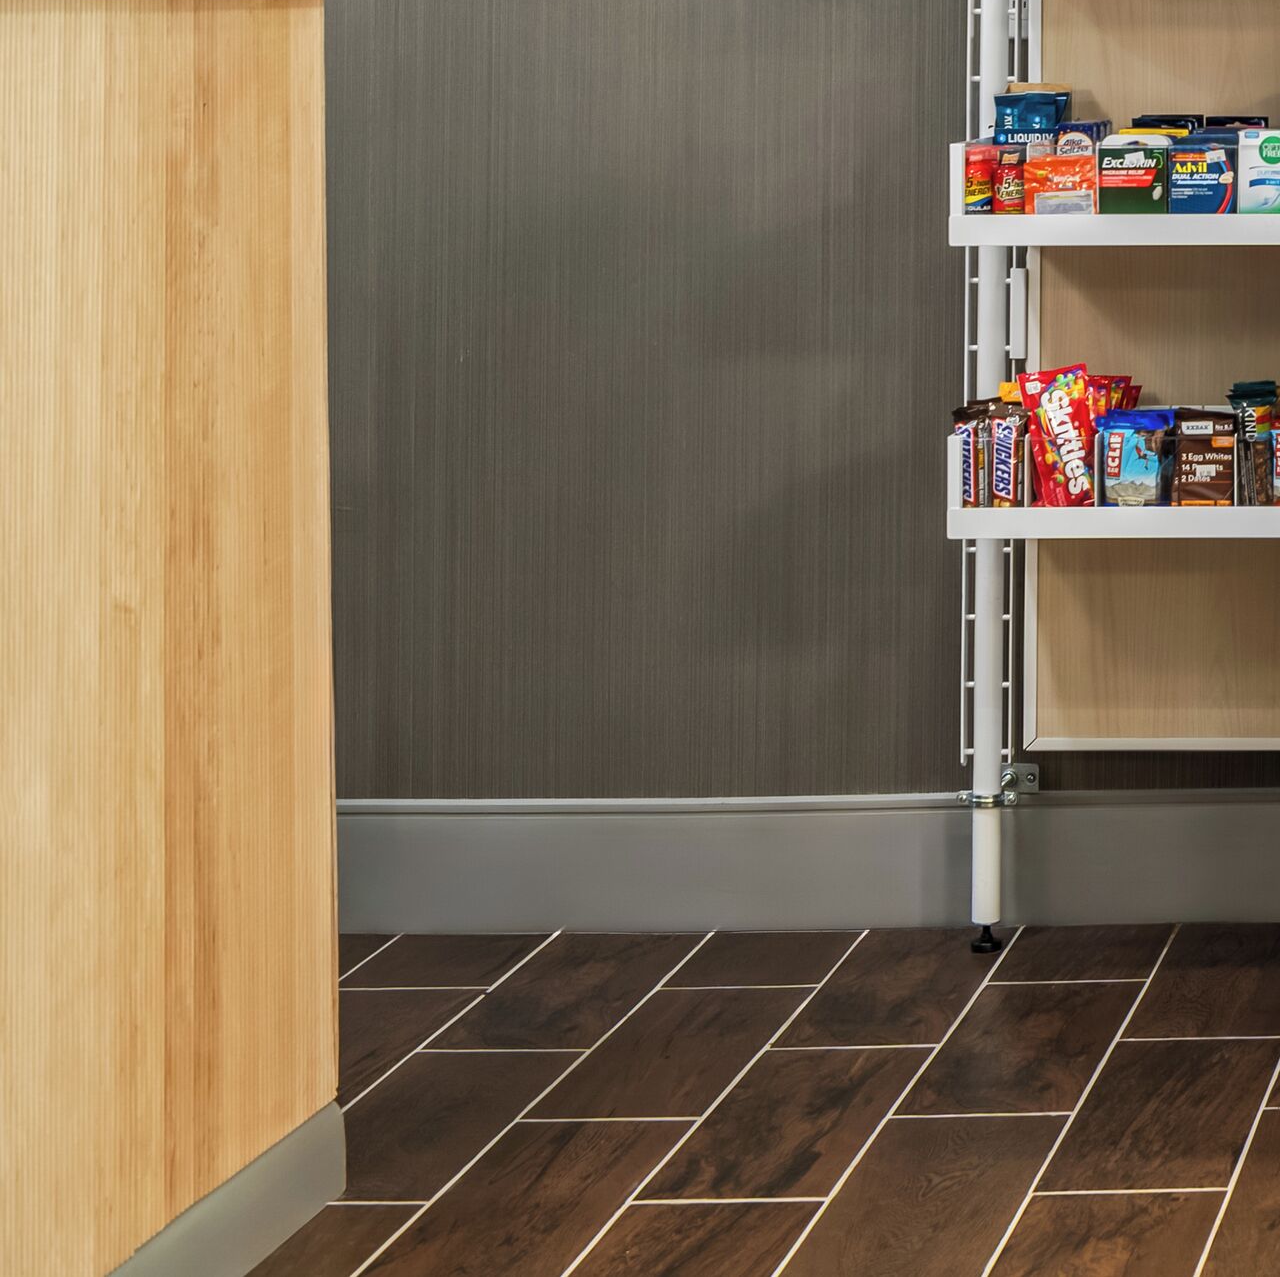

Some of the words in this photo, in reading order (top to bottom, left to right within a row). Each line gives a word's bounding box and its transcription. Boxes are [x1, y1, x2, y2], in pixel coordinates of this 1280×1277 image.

[1059, 146, 1089, 155] Seltzer
[1172, 162, 1207, 173] Advil
[1244, 408, 1257, 442] KIND
[992, 419, 1014, 498] SNICKERS
[1041, 389, 1090, 496] Skittles
[1108, 432, 1124, 466] CLIF
[1188, 452, 1201, 461] Egg
